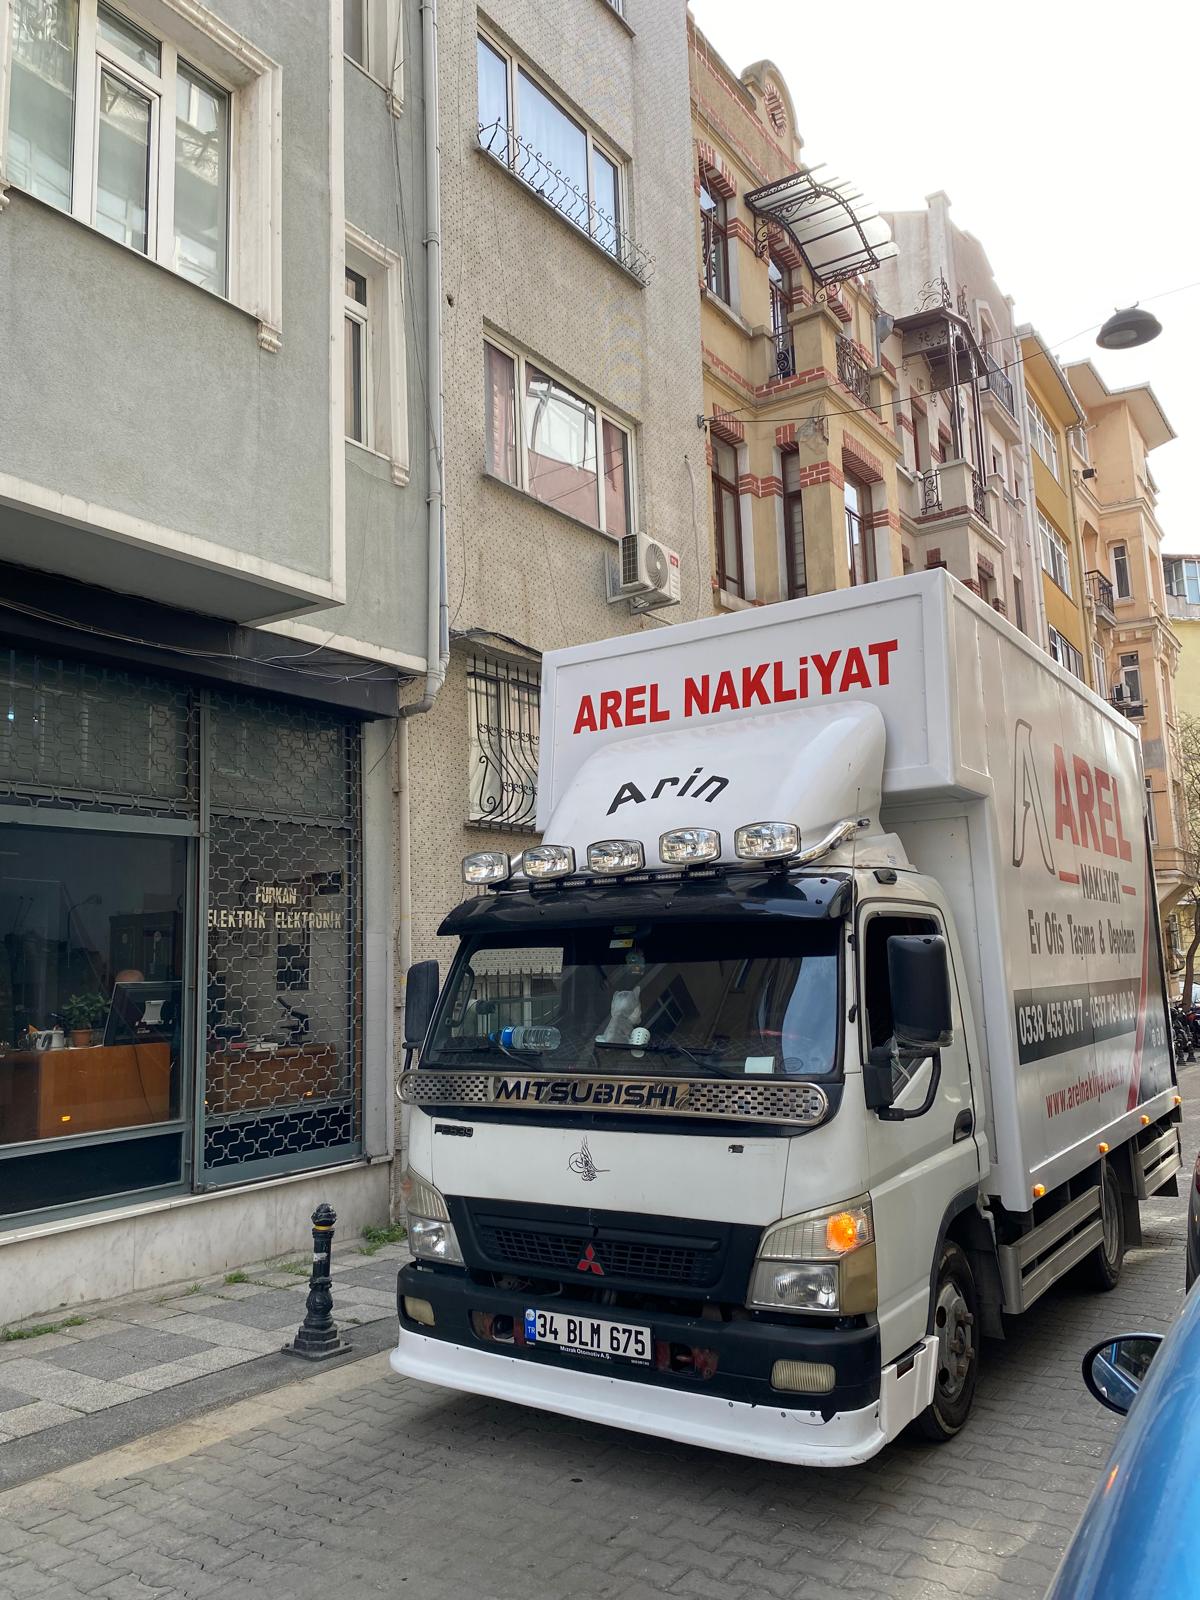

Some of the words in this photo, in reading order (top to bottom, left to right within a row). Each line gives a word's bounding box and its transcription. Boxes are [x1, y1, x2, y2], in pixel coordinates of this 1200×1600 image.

[572, 683, 670, 735] AREL
[606, 767, 730, 816] Arin
[1054, 743, 1132, 862] AREL
[255, 886, 297, 904] FURKAN
[1028, 909, 1041, 954] Ev
[1044, 911, 1065, 955] Ofis
[1098, 919, 1106, 955] &
[1107, 918, 1136, 963] Depolama
[1018, 1004, 1045, 1045] 0538
[1046, 1001, 1063, 1039] 455
[1090, 995, 1106, 1029] 0537
[495, 1079, 678, 1107] MITSUBISHI
[527, 1326, 536, 1334] TR
[537, 1313, 559, 1341] 34
[567, 1318, 601, 1349] BLM
[609, 1326, 646, 1356] 675
